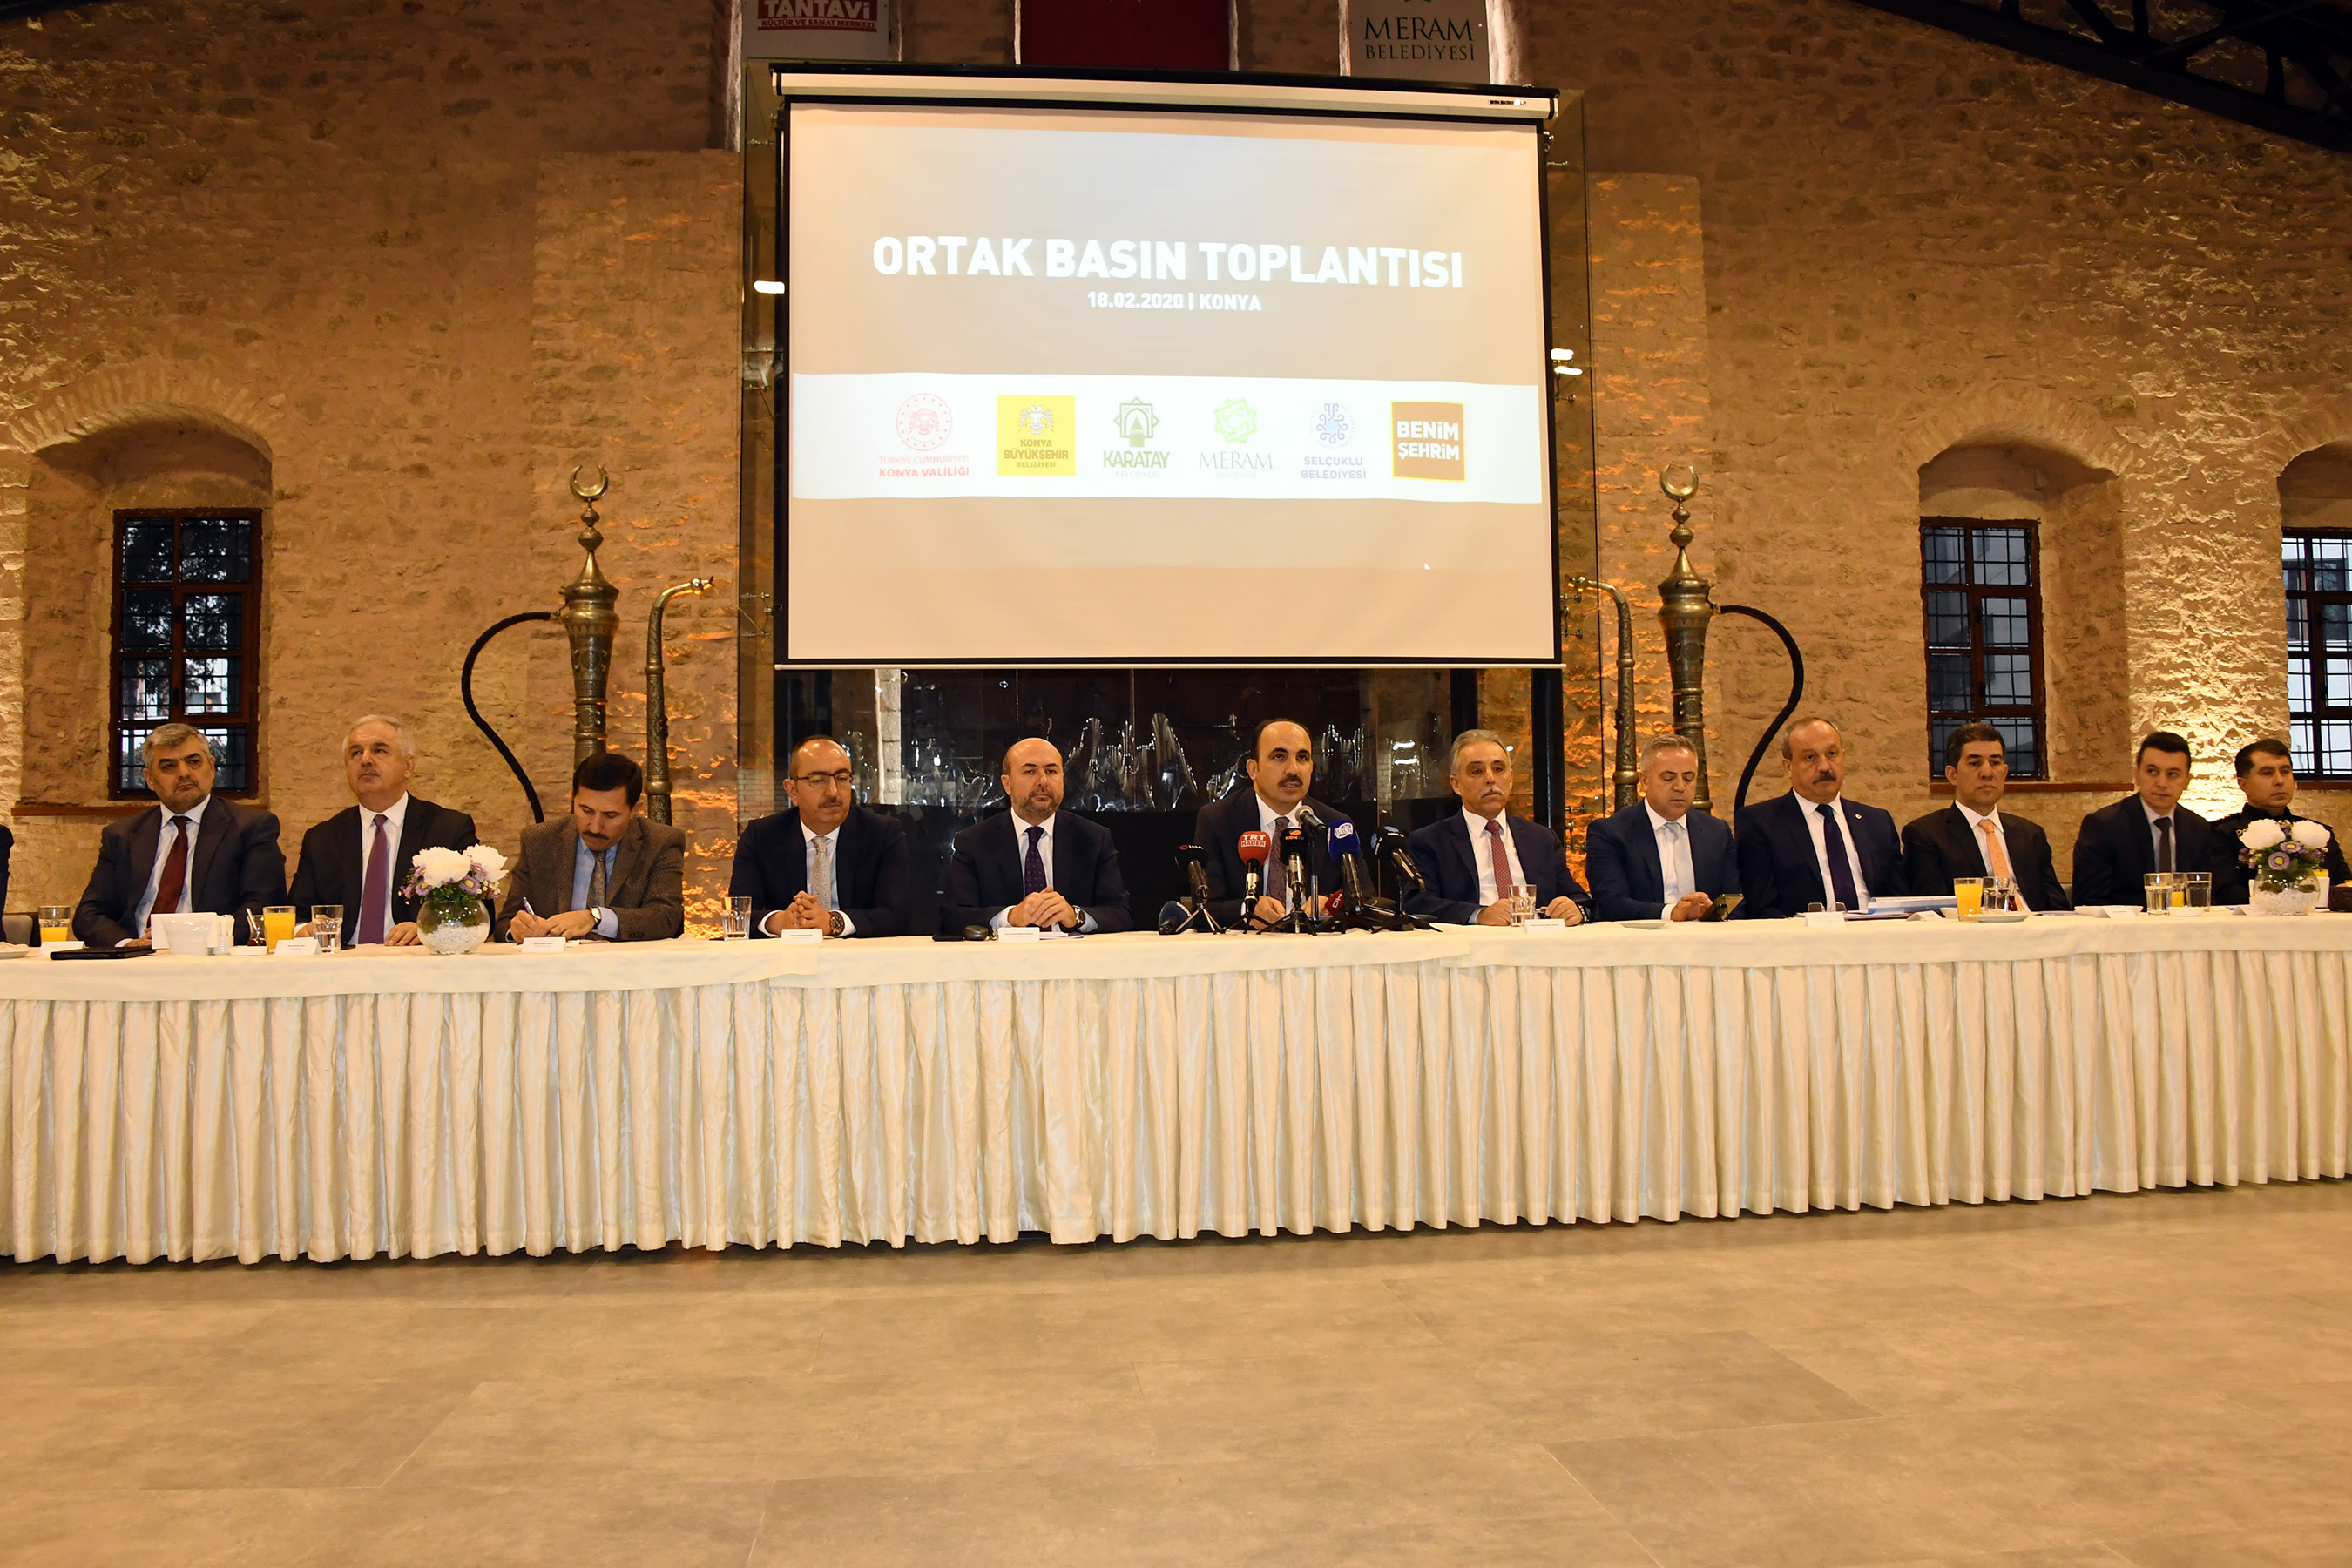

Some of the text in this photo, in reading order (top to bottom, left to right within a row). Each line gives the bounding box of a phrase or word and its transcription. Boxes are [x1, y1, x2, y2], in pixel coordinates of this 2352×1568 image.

[762, 18, 794, 27] KÜLTÜR
[1364, 17, 1474, 41] MERAM
[1365, 43, 1475, 61] BELEDİYESİ
[873, 235, 1463, 288] ORTAK BASIN TOPLANTISI
[1087, 291, 1184, 309] 18.02.2020
[1199, 293, 1263, 312] KONYA
[1103, 450, 1171, 469] KARATAY
[1199, 451, 1274, 470] MERAM
[1303, 456, 1363, 468] SELÇUKLU
[879, 468, 919, 477] KONYA
